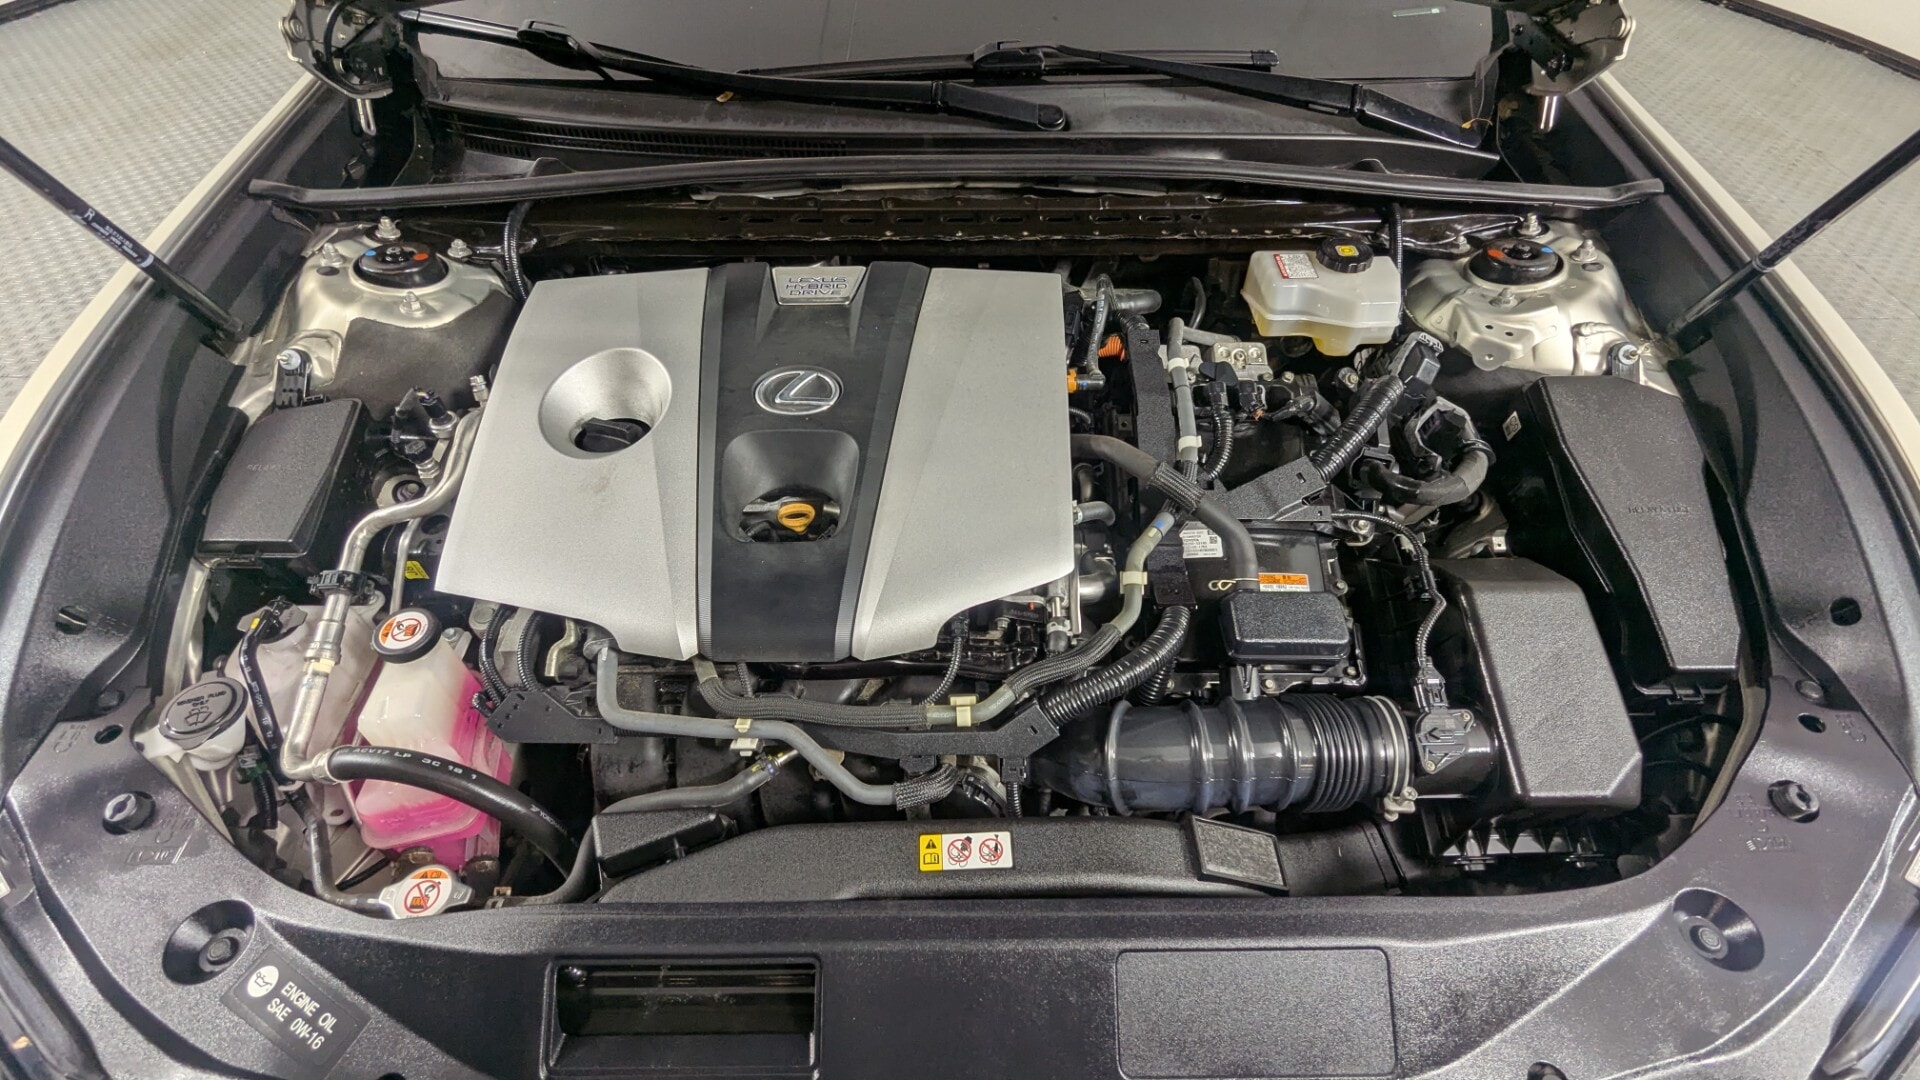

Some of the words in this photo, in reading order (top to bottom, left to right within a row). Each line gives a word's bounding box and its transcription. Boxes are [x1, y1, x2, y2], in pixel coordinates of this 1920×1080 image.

[84, 208, 96, 221] R
[267, 998, 292, 1022] SAE
[290, 1017, 325, 1050] 0W-16
[281, 981, 320, 1017] ENGINE
[318, 1012, 337, 1034] OIL
